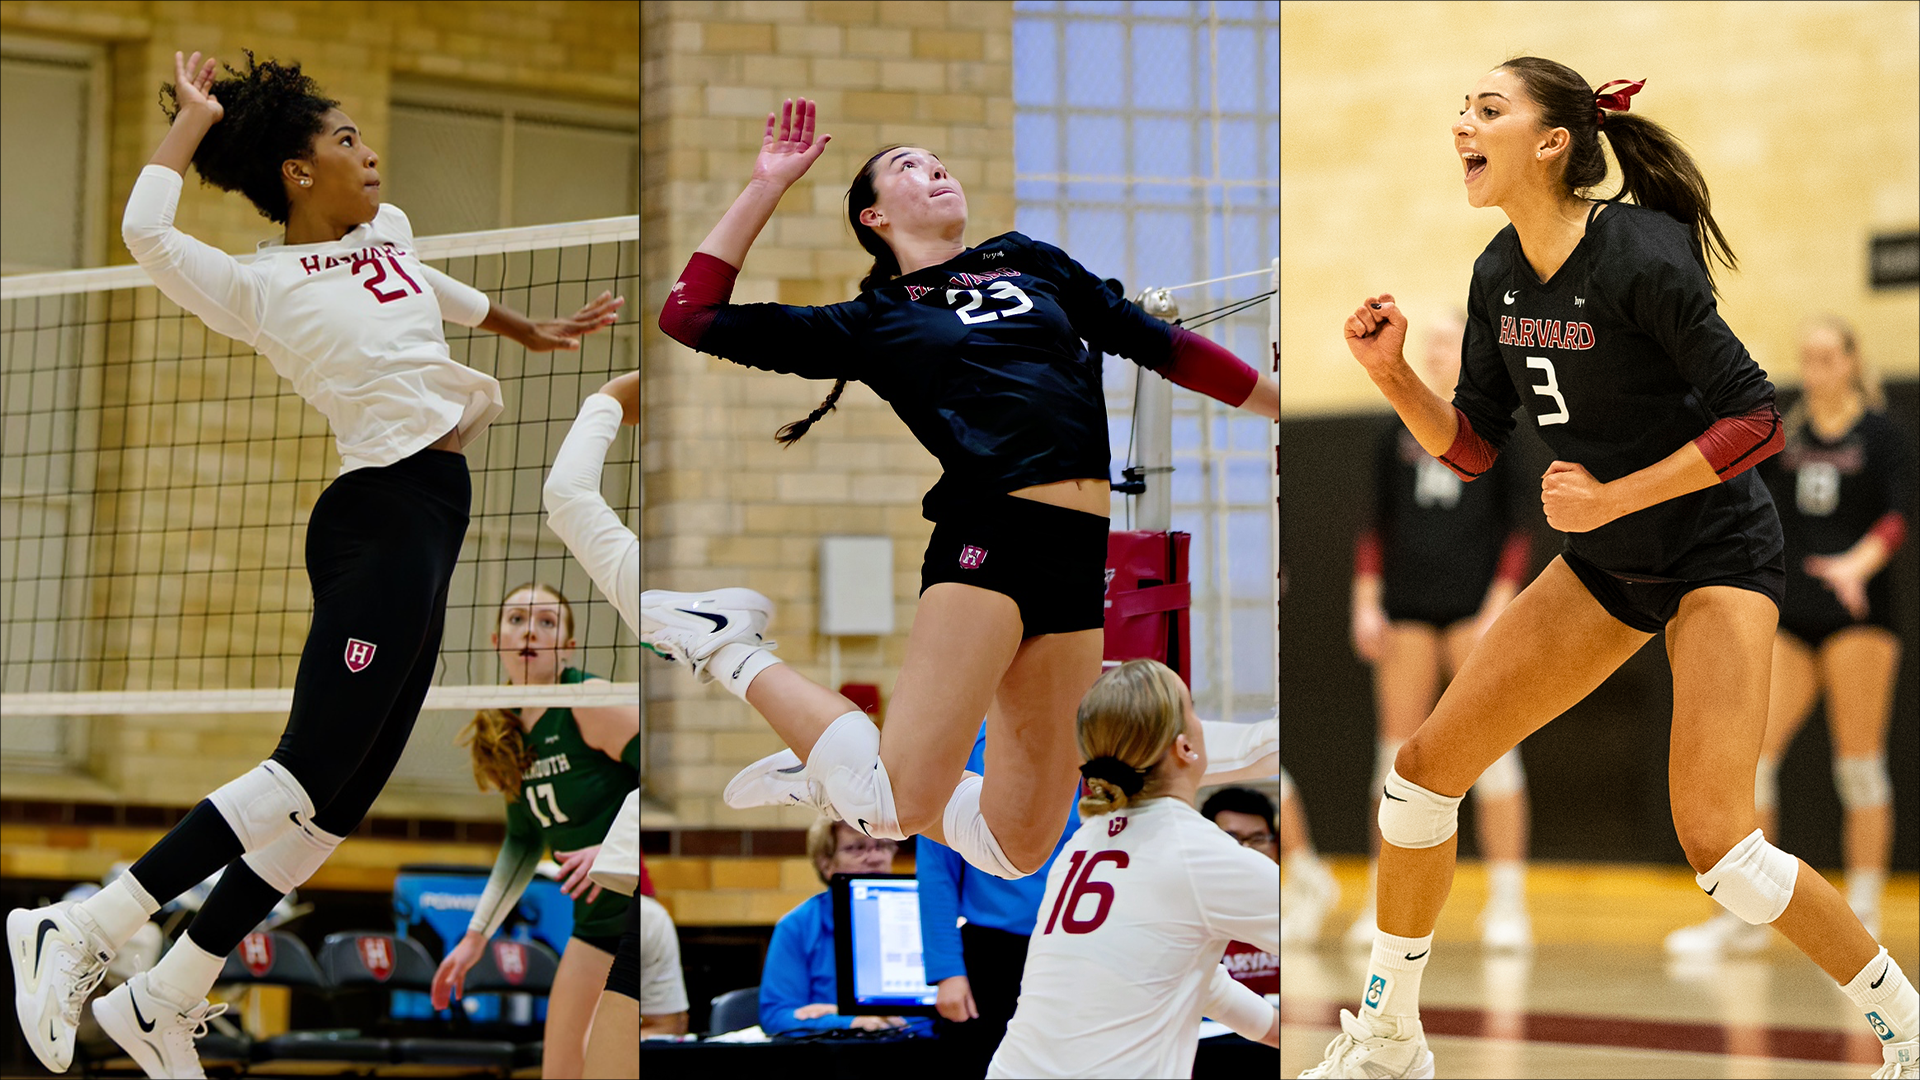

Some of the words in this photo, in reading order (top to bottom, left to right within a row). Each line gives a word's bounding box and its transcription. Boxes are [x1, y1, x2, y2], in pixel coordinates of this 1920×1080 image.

[351, 255, 423, 304] 21
[945, 280, 1034, 325] 23
[1498, 315, 1595, 350] HARVARD
[1526, 356, 1570, 426] 3
[349, 643, 369, 665] H
[526, 783, 570, 828] 17
[1043, 850, 1130, 936] 16
[365, 938, 390, 969] H
